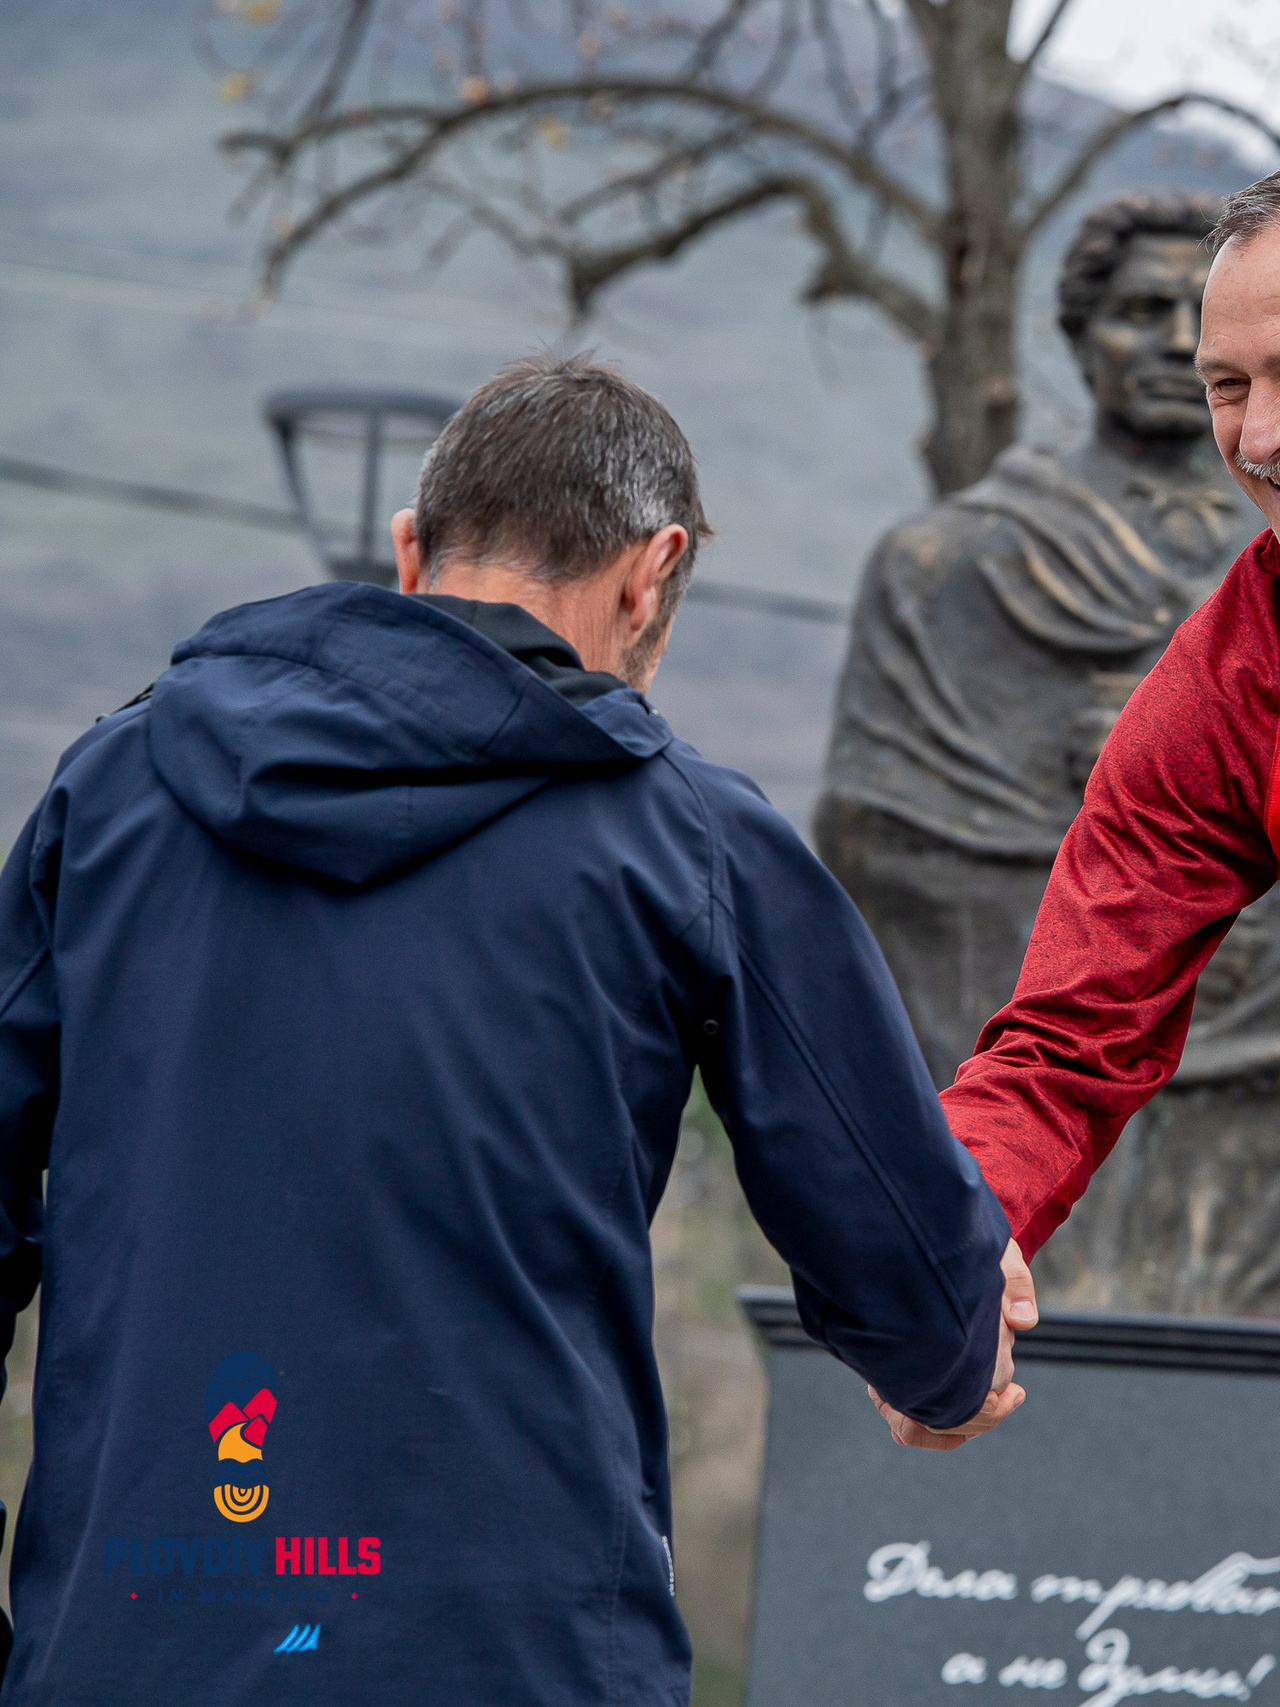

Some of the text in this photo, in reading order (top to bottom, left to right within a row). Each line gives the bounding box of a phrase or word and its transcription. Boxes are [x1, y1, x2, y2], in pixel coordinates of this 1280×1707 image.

[863, 1540, 1018, 1603] Дела
[941, 1652, 988, 1685] а
[998, 1654, 1068, 1690] не
